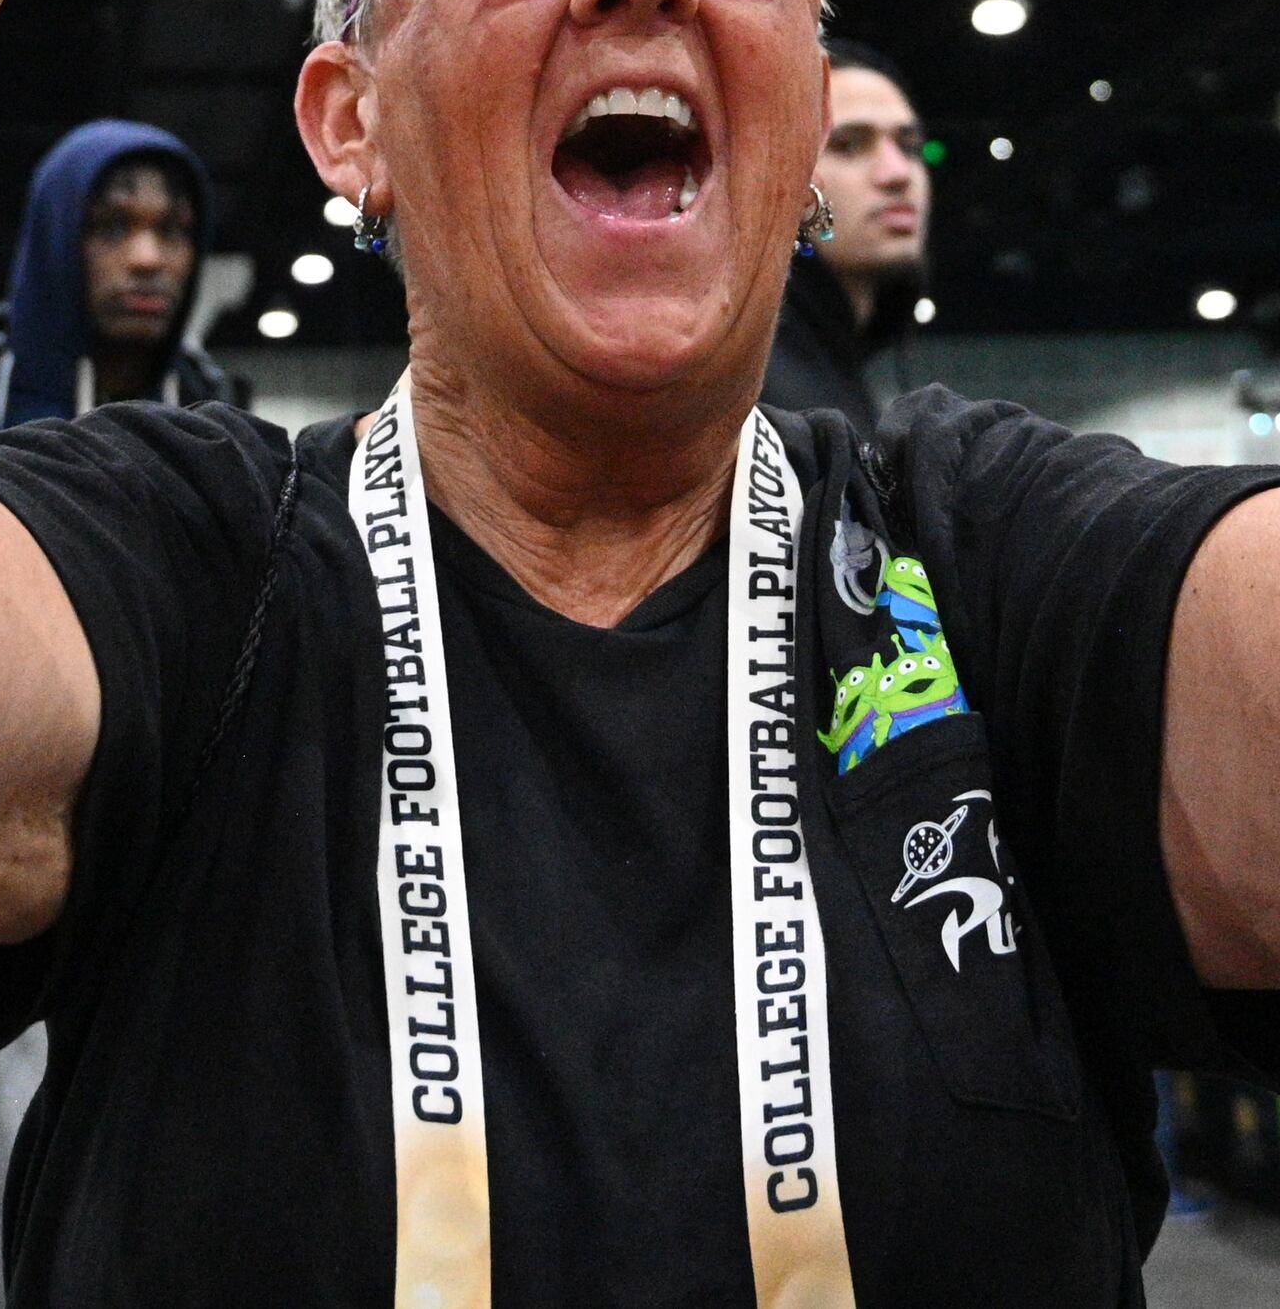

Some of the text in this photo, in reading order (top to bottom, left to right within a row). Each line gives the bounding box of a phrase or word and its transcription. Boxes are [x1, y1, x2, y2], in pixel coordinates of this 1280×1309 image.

[375, 557, 440, 826] FOOTBALL
[749, 413, 819, 1213] COLLEGE FOOTBALL PLAYOFF
[395, 844, 463, 1125] COLLEGE
